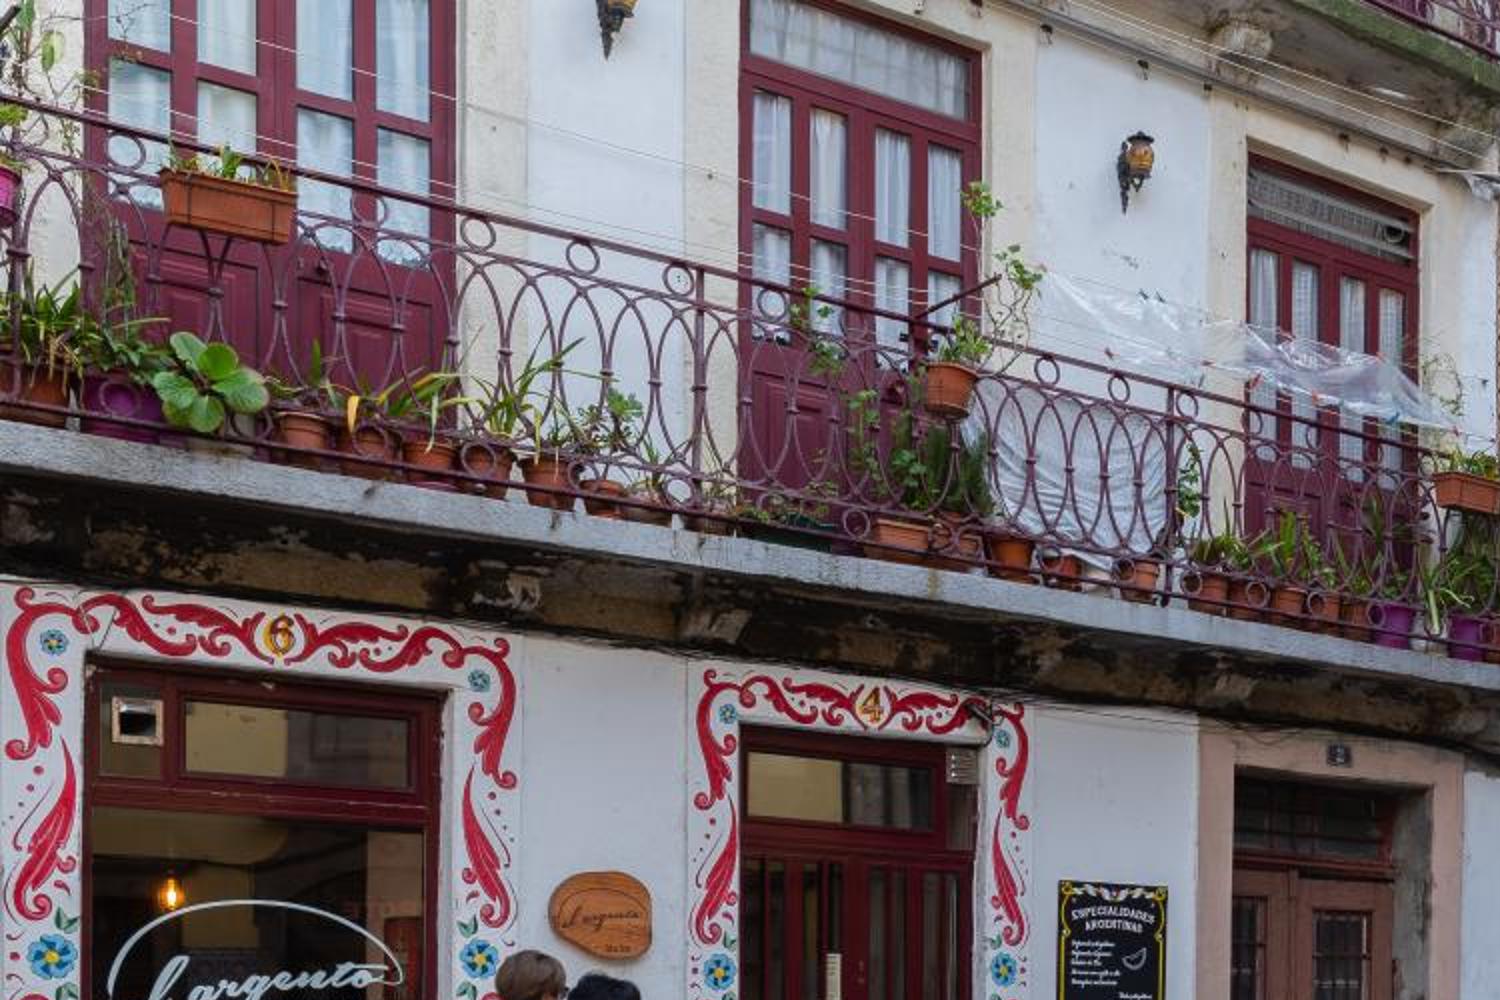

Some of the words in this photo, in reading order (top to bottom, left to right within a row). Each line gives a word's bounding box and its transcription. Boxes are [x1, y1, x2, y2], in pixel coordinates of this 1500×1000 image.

[265, 613, 295, 656] 6
[858, 686, 883, 722] 4
[1071, 906, 1156, 925] ESPECIALIDADES
[1085, 919, 1144, 933] ARGENTINAS
